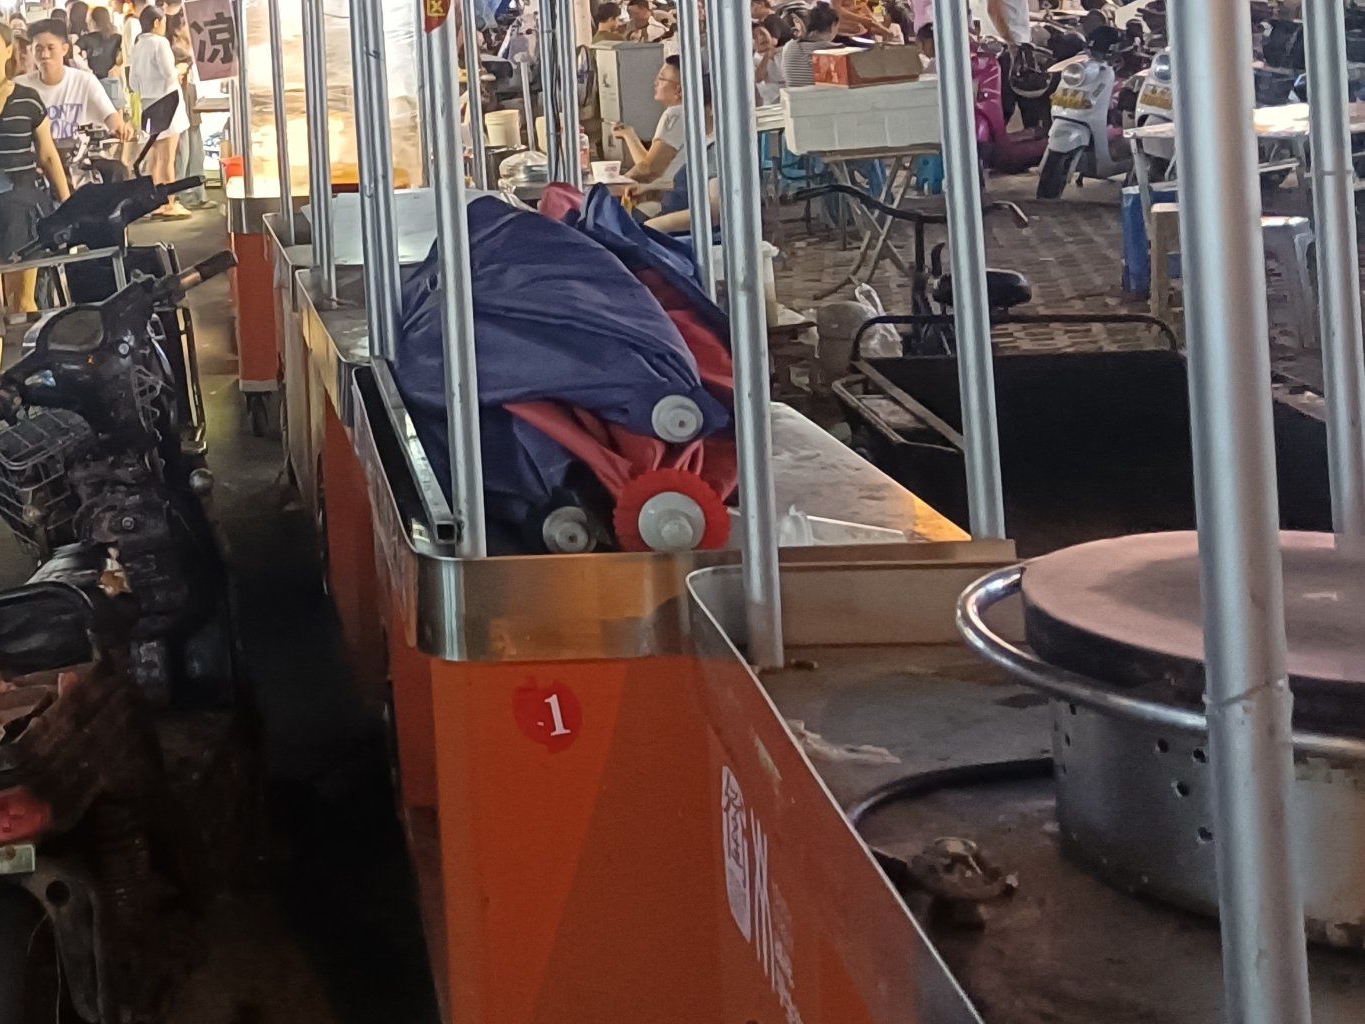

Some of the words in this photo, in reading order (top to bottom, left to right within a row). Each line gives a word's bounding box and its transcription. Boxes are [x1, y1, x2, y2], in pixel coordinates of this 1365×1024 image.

[190, 12, 234, 65] 凉
[47, 103, 83, 121] ON'T
[544, 693, 571, 736] 1
